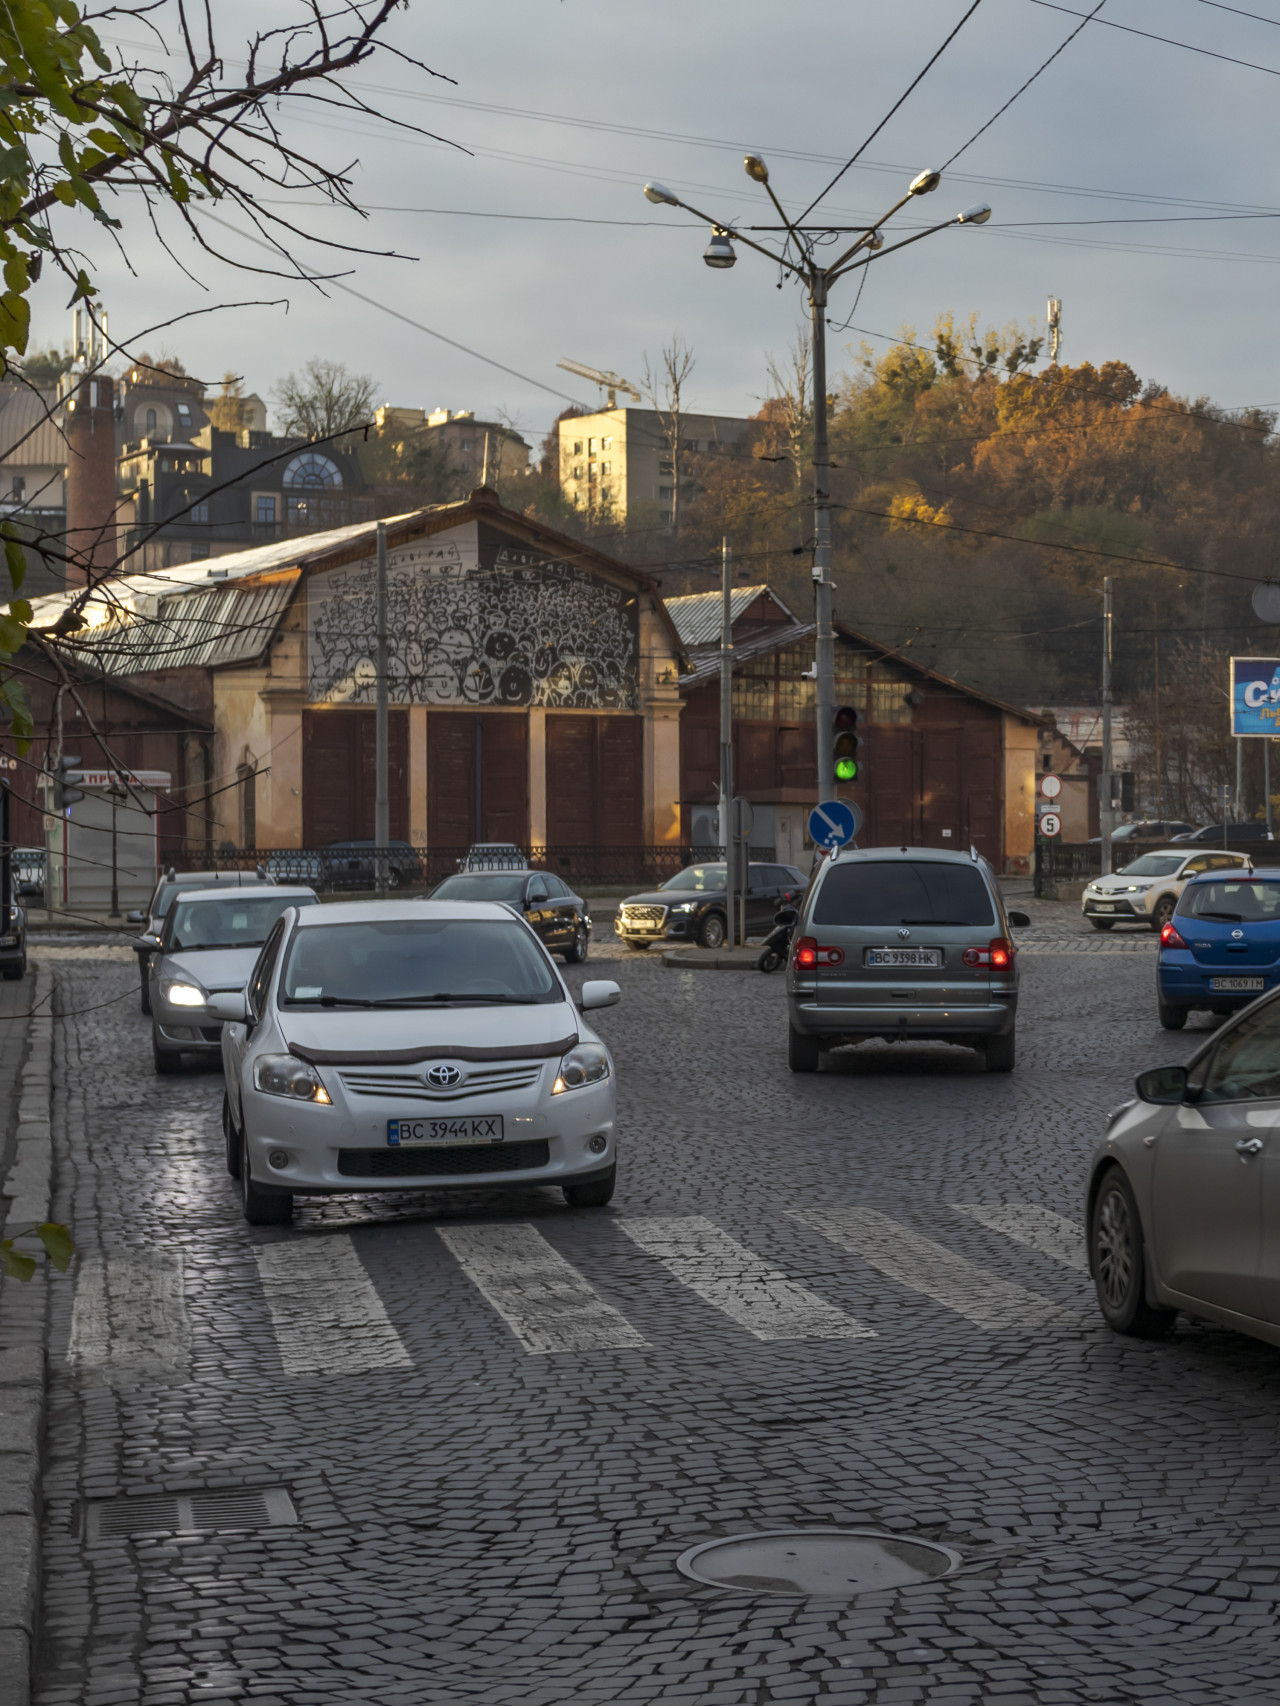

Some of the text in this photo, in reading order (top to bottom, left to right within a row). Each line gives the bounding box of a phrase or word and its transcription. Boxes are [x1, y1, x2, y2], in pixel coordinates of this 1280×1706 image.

[1046, 817, 1054, 832] 5
[875, 953, 934, 964] BC 9398 HK
[1214, 978, 1227, 988] BC
[1229, 978, 1248, 988] 1069
[400, 1119, 496, 1140] BC 3944 KX
